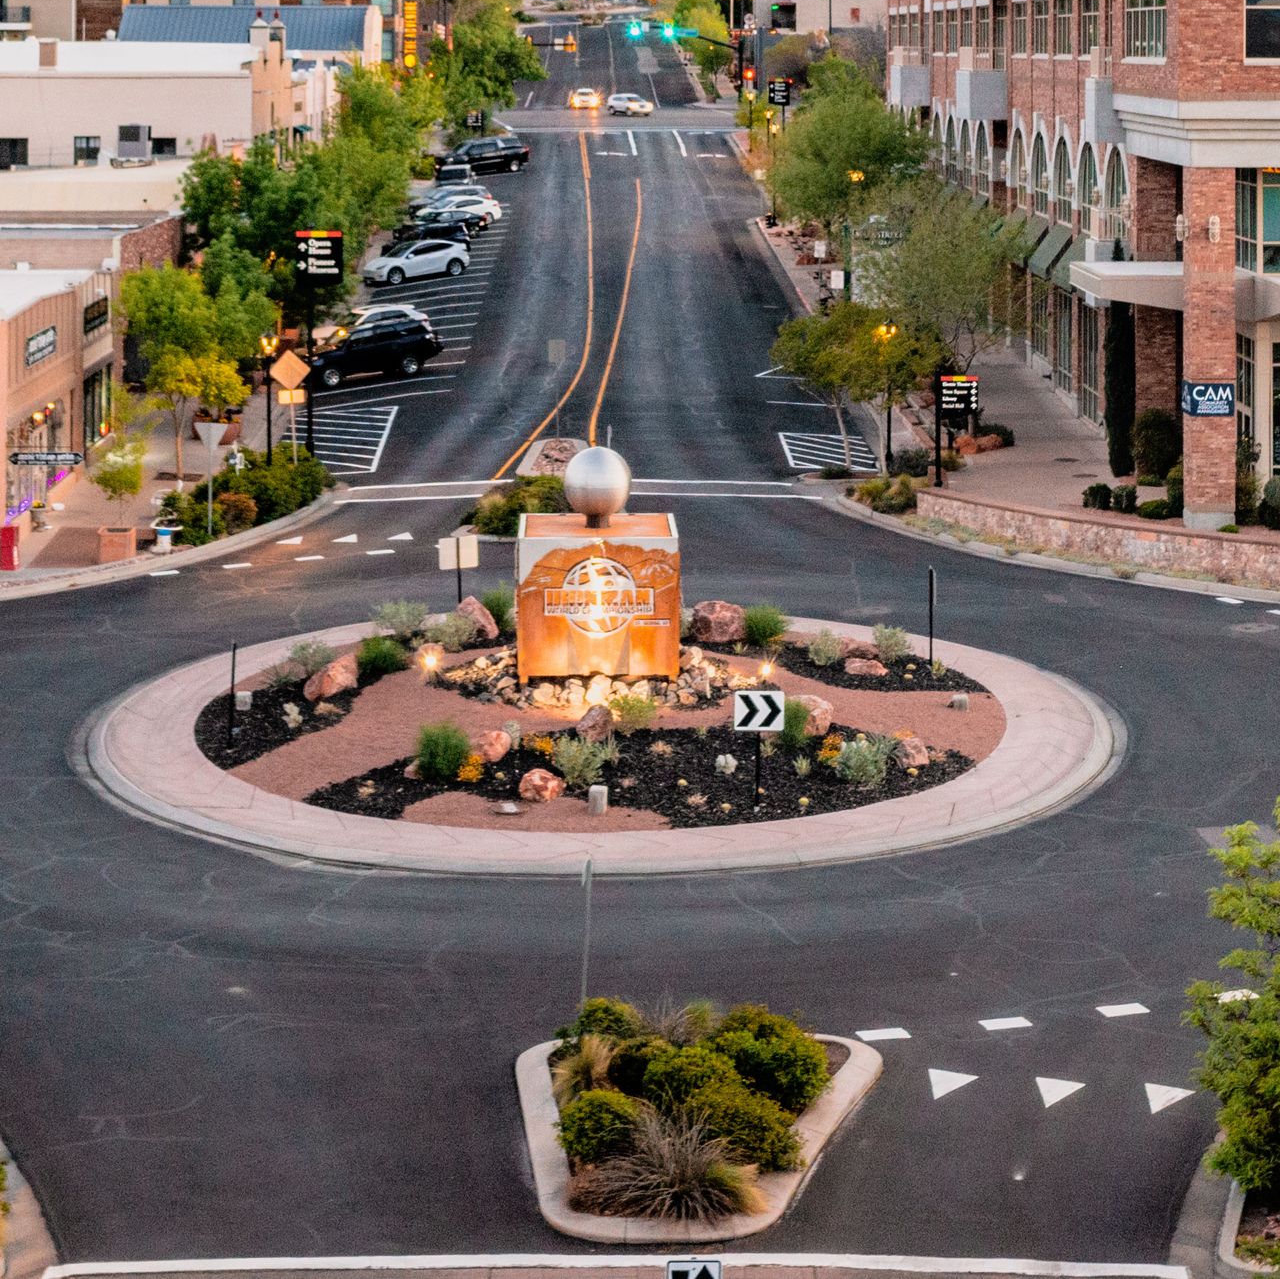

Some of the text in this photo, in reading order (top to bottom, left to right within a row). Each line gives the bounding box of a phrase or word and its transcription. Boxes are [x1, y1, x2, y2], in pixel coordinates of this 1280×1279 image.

[308, 238, 332, 248] Opera
[308, 247, 331, 255] House
[308, 257, 336, 266] Pioneer
[308, 266, 339, 274] Museum
[1192, 385, 1233, 401] CAM
